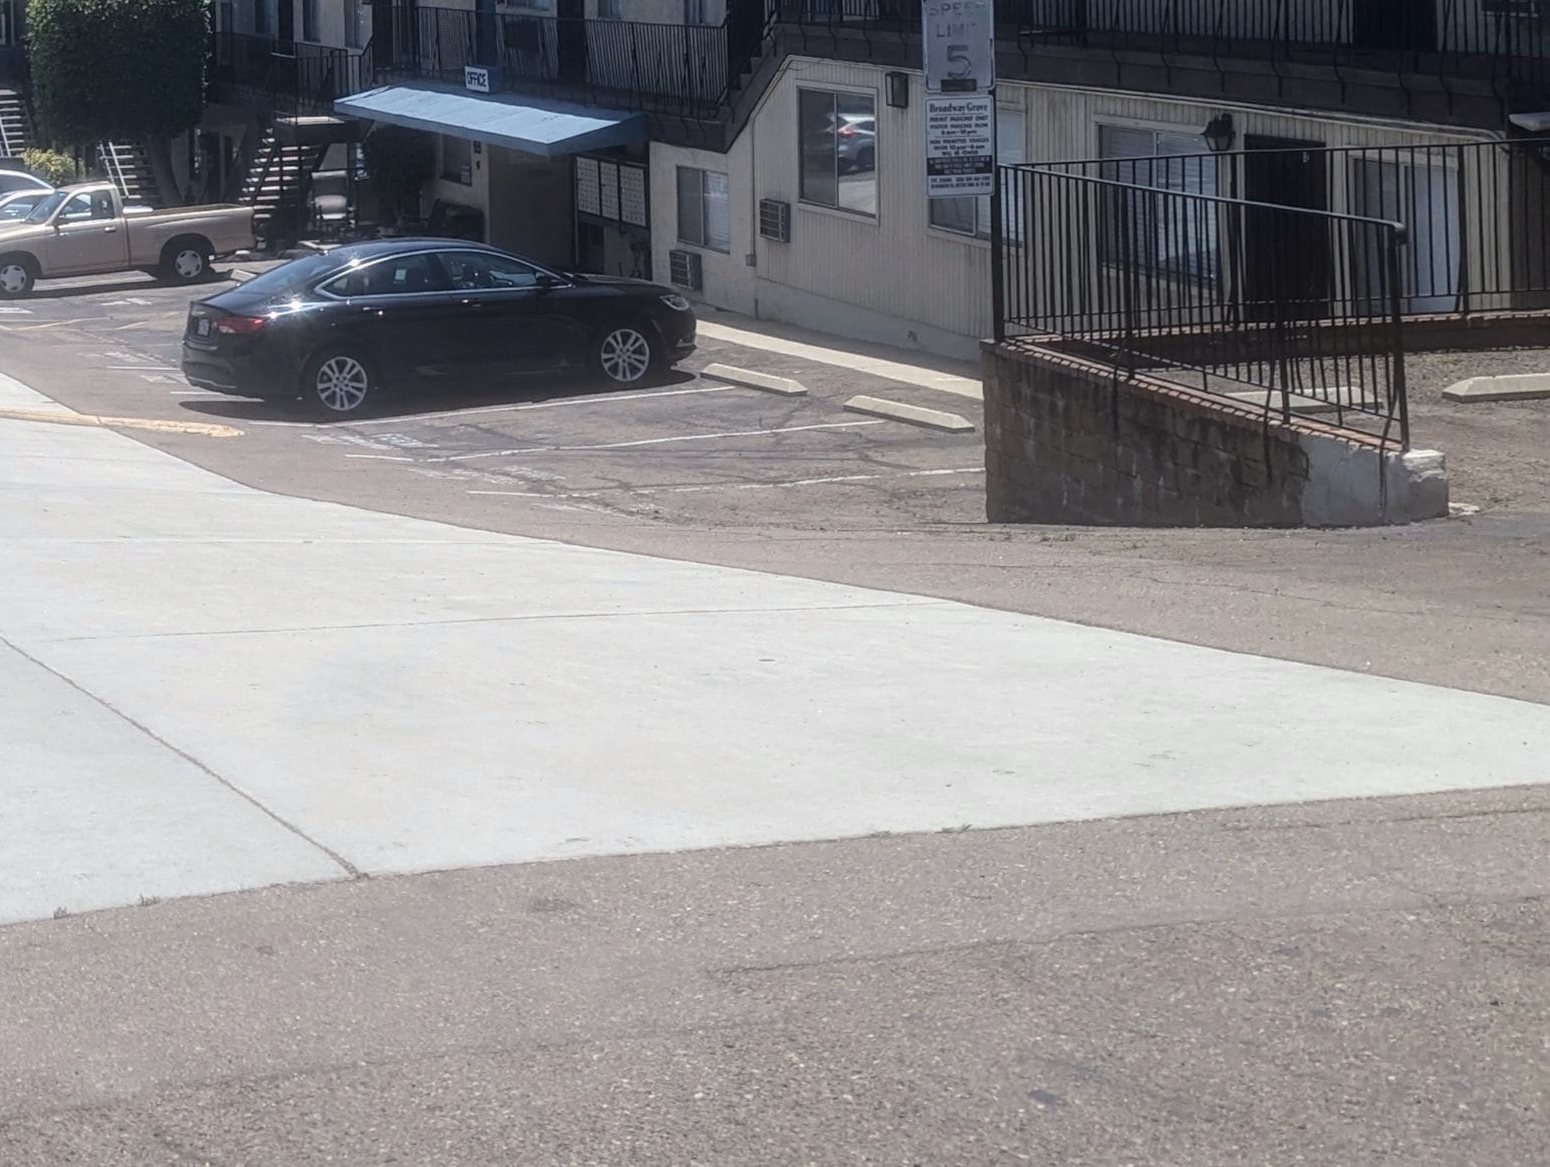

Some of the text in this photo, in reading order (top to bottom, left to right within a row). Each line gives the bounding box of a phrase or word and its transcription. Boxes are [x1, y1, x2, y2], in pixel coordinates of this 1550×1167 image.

[928, 1, 986, 16] SPEE
[936, 22, 976, 38] LIMI
[947, 44, 971, 79] 5
[467, 71, 487, 87] OFFICE
[930, 102, 988, 114] Broadway Grove
